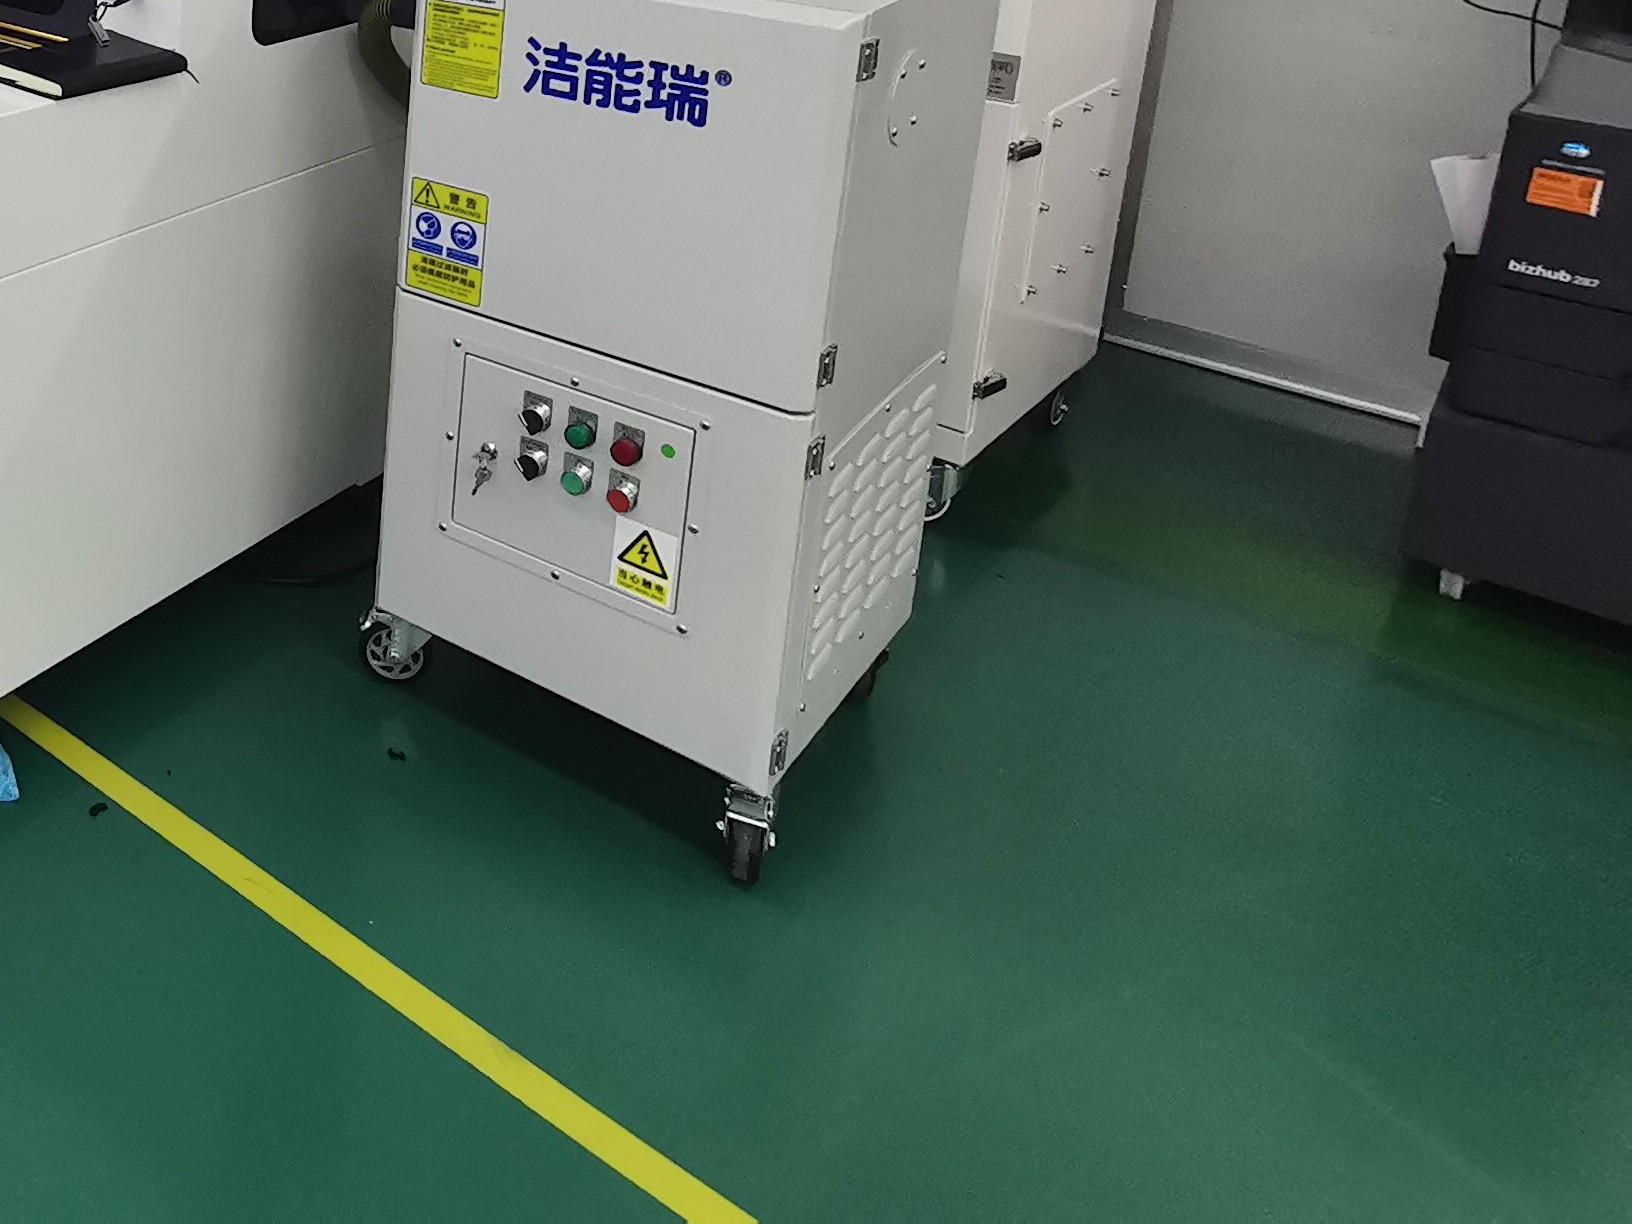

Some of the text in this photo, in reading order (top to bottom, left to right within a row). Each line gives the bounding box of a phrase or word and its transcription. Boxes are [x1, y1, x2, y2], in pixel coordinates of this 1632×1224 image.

[522, 35, 711, 129] 洁能瑞
[1507, 259, 1572, 283] bizhub
